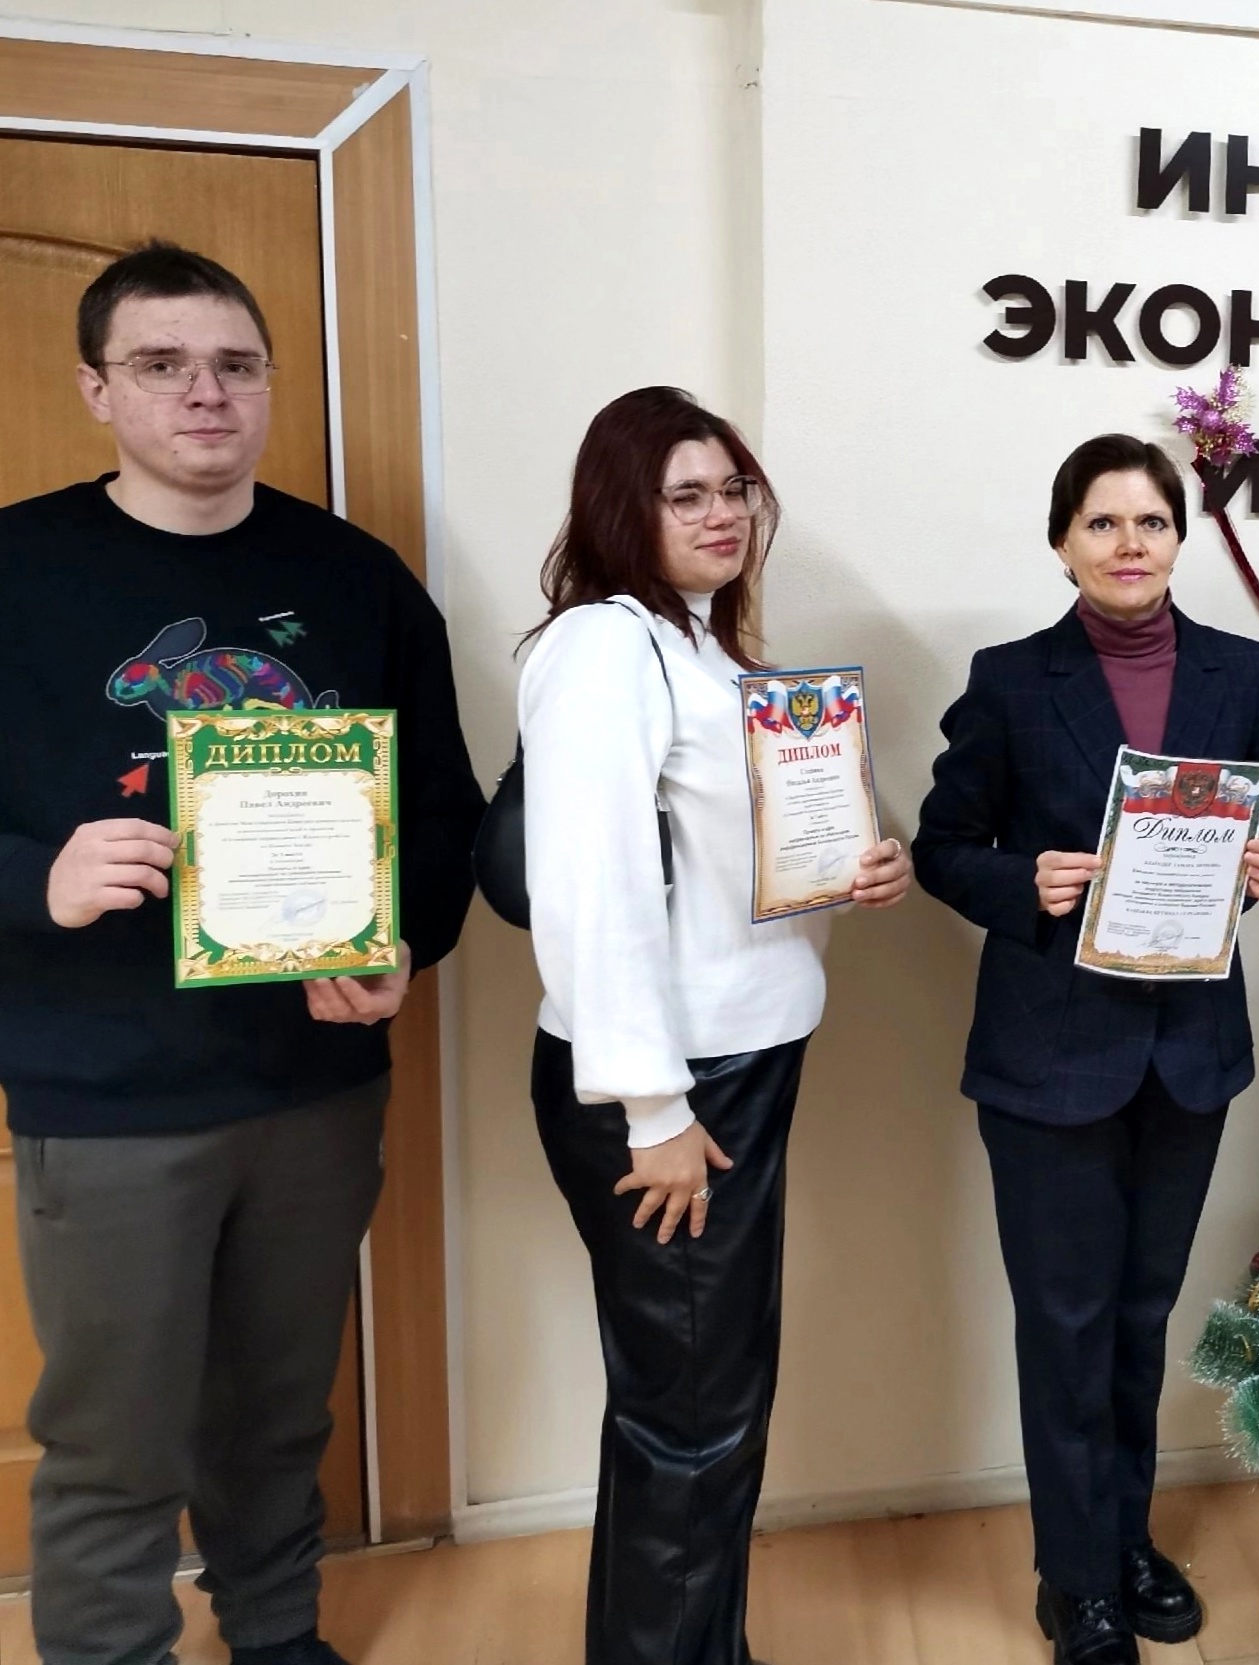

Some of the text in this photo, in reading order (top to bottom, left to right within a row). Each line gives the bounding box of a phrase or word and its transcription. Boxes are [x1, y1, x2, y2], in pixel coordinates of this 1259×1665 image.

[205, 742, 363, 768] ДИПЛОМ
[777, 742, 842, 766] ДИПЛОМ
[1132, 816, 1236, 844] Диплом
